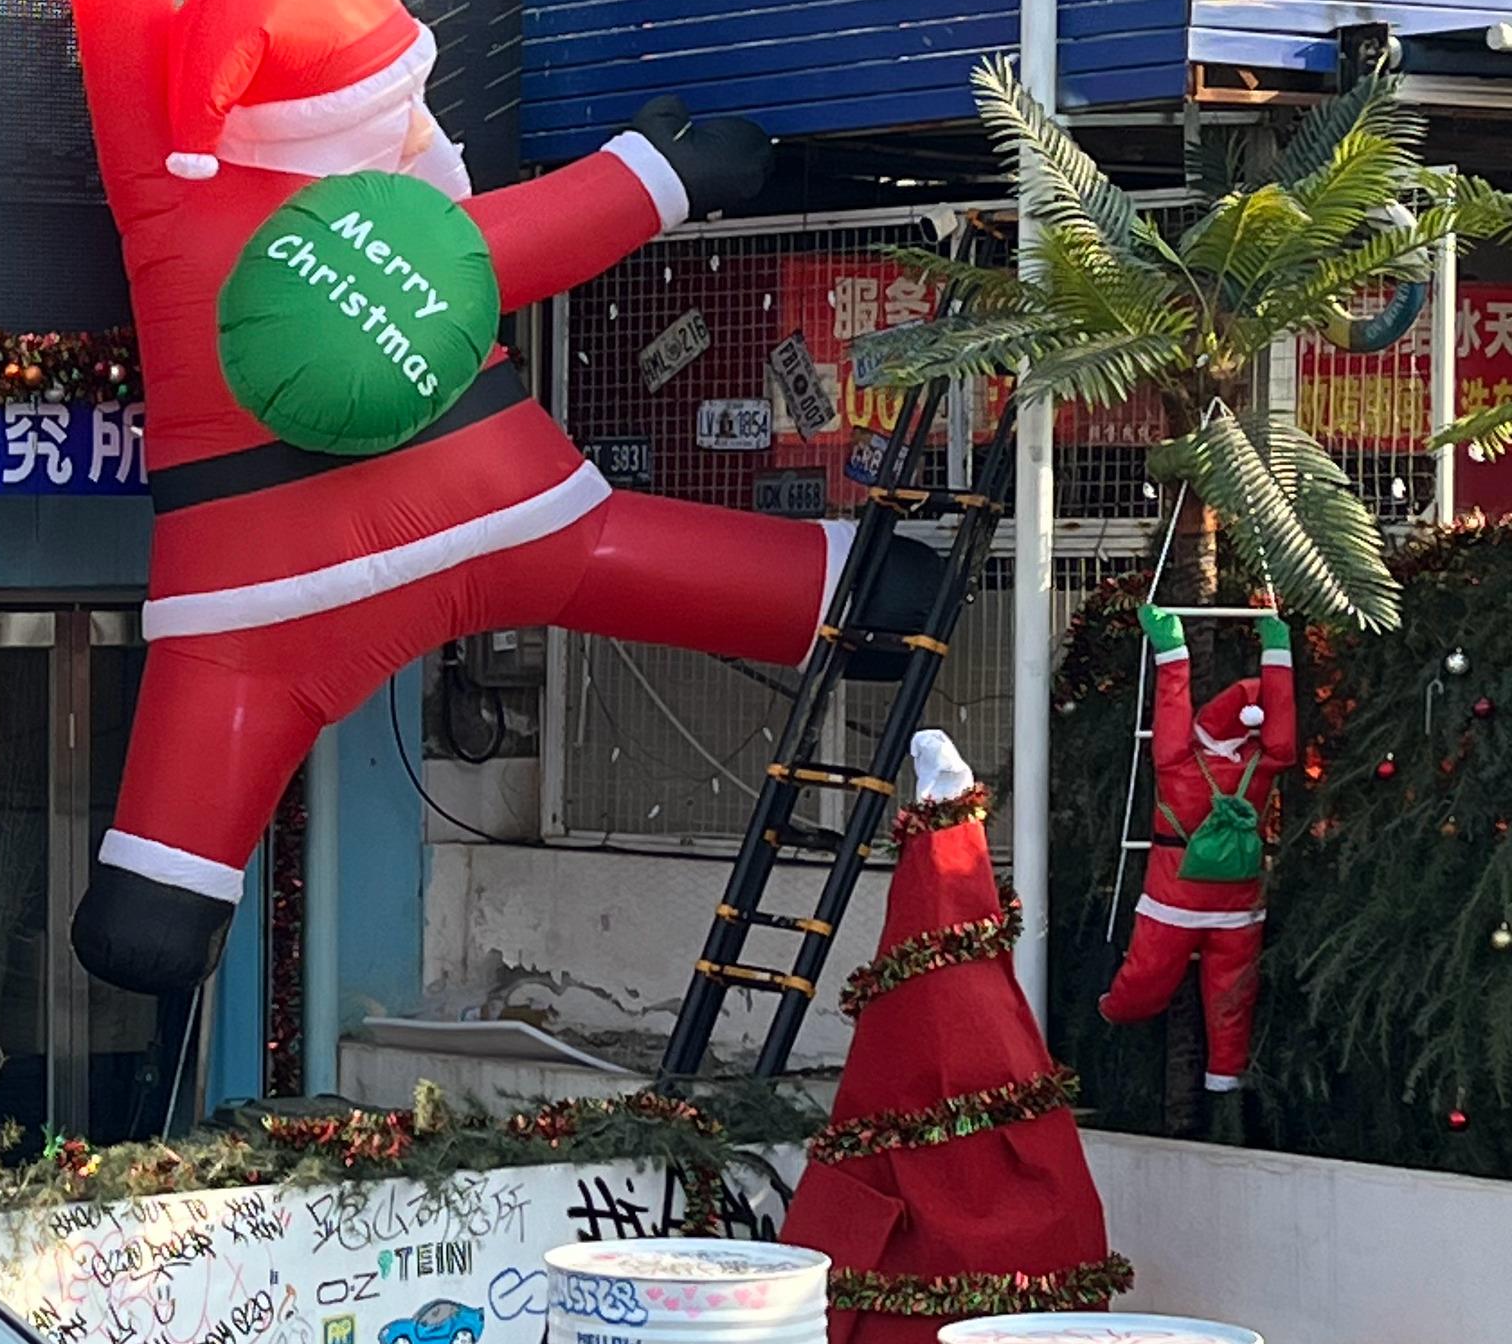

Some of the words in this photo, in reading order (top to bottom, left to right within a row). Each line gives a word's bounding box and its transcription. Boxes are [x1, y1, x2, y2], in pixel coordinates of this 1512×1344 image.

[266, 233, 439, 398] Christmas
[329, 210, 449, 320] Merry
[800, 394, 826, 430] 007
